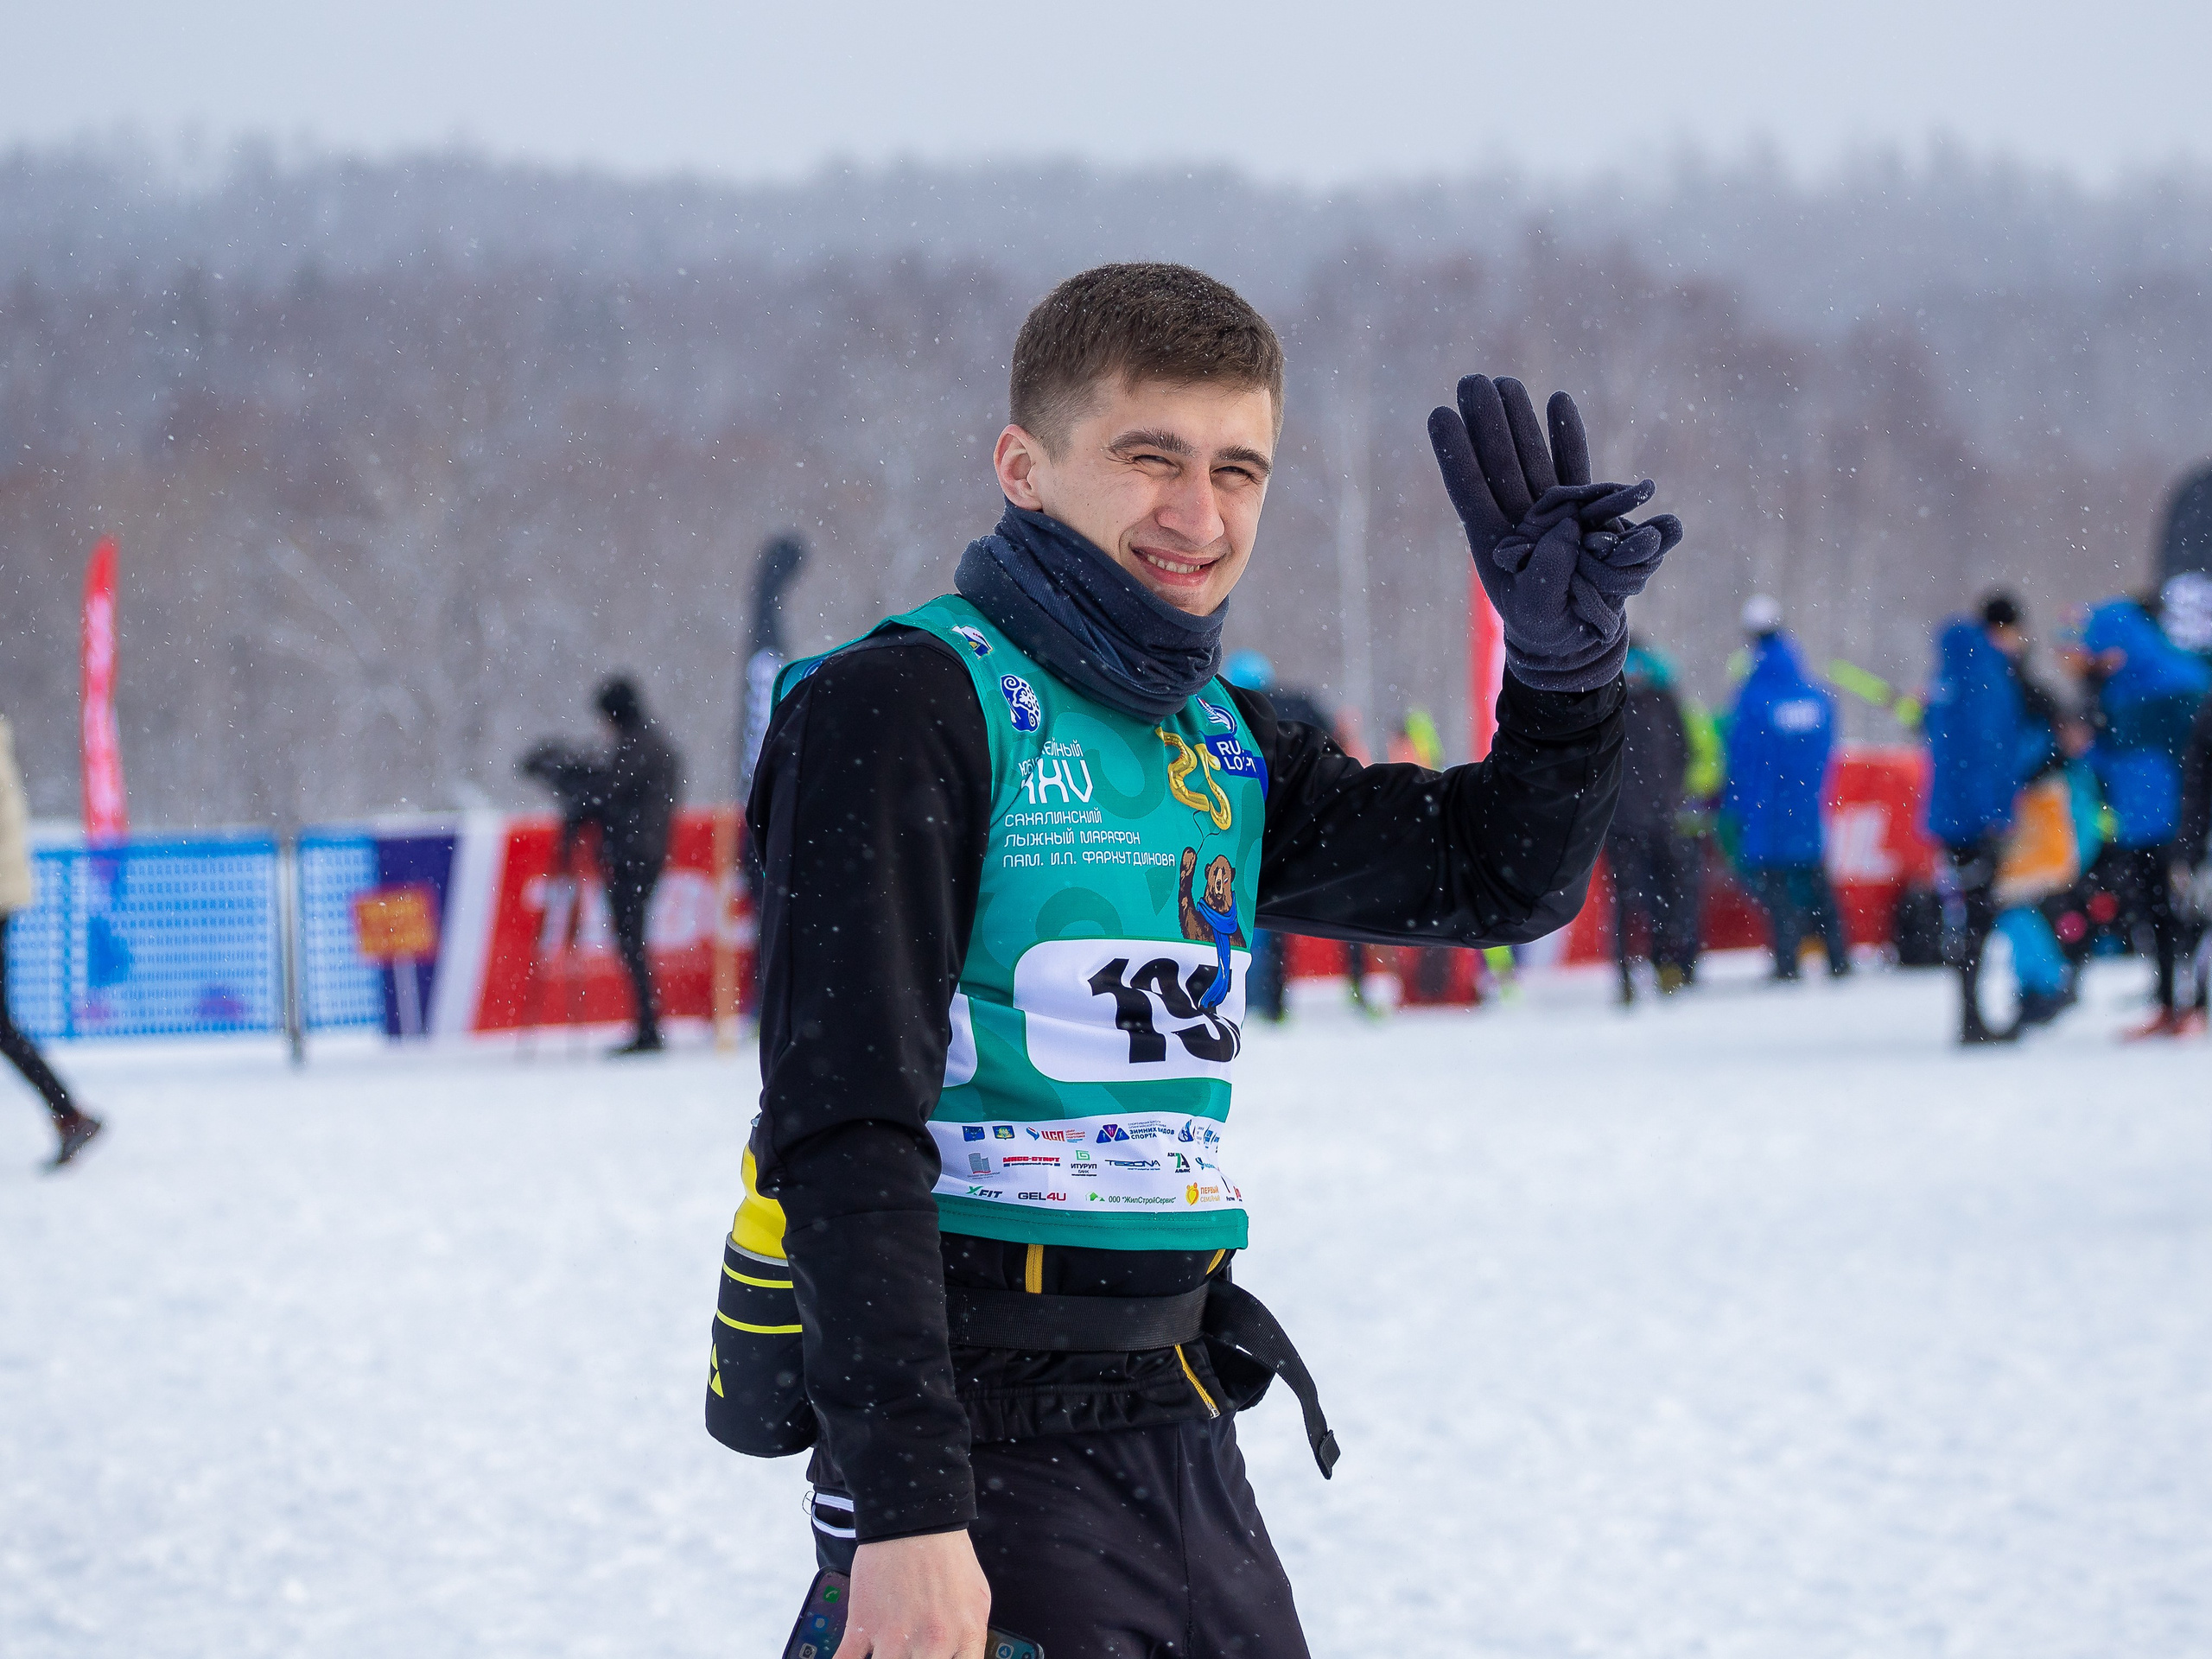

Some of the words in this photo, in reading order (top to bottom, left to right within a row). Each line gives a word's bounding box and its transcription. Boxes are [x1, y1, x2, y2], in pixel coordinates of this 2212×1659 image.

[1005, 807, 1103, 827] САХАЛИНСКИЙ
[1004, 827, 1075, 848] ЛЫЖНЫЙ
[1080, 830, 1141, 845] МАРАФОН
[1002, 853, 1044, 868] ПАМ.
[1051, 851, 1077, 866] И.П.
[1082, 850, 1175, 867] ФАРХУТДИНОВА
[1041, 1130, 1065, 1142] ЦСП
[1018, 1192, 1067, 1201] GEL4U
[1200, 1185, 1219, 1195] ПЕРВЫЙ
